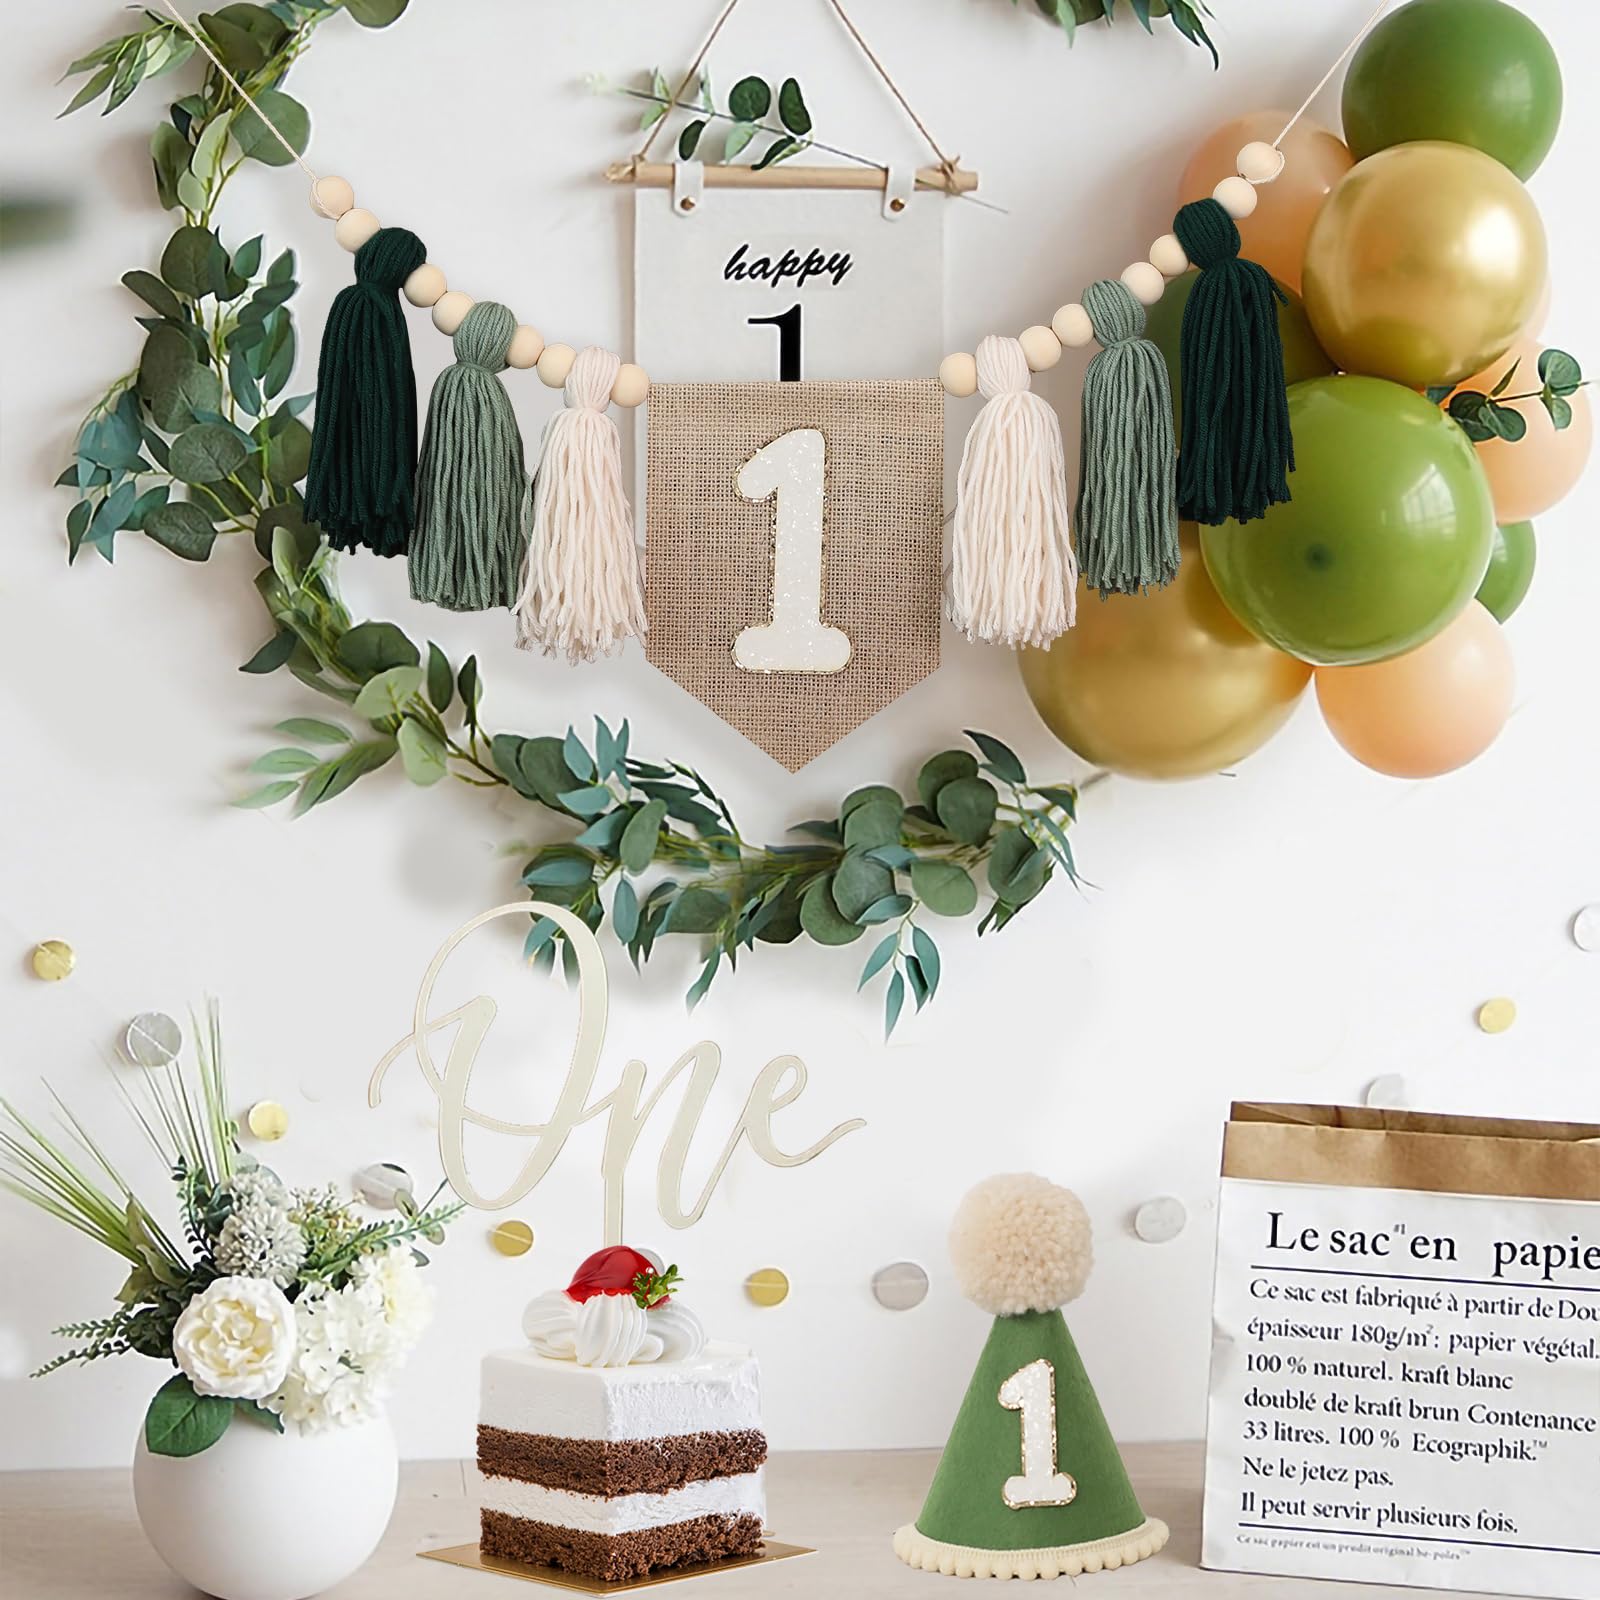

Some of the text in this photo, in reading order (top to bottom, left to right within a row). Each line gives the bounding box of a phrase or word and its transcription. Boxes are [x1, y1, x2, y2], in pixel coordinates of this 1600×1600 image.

[724, 243, 853, 288] happy
[731, 425, 853, 675] 1
[368, 900, 868, 1230] One
[1266, 1211, 1319, 1251] Le
[1410, 1235, 1457, 1260] en
[1491, 1235, 1600, 1281] papie
[1250, 1278, 1278, 1299] Ce
[1284, 1285, 1315, 1303] sac
[1321, 1287, 1348, 1305] est
[1355, 1285, 1442, 1316] fabriqué
[1447, 1293, 1459, 1312] à
[1465, 1297, 1524, 1318] partir
[1528, 1297, 1554, 1318] de
[1247, 1317, 1343, 1341] épaisseur
[1449, 1331, 1516, 1356] papier
[1247, 1354, 1514, 1390] 100 % naturel. kraft blanc
[1244, 1387, 1597, 1432] doublé de kraft brun Contenance
[998, 1358, 1077, 1510] 1
[1243, 1420, 1268, 1440] 33
[1274, 1420, 1330, 1445] litres.
[1340, 1426, 1374, 1446] 100
[1380, 1429, 1400, 1449] %
[1243, 1456, 1394, 1490] Ne le jetez pas.
[1241, 1492, 1518, 1534] Il peut servir plusieurs fois.
